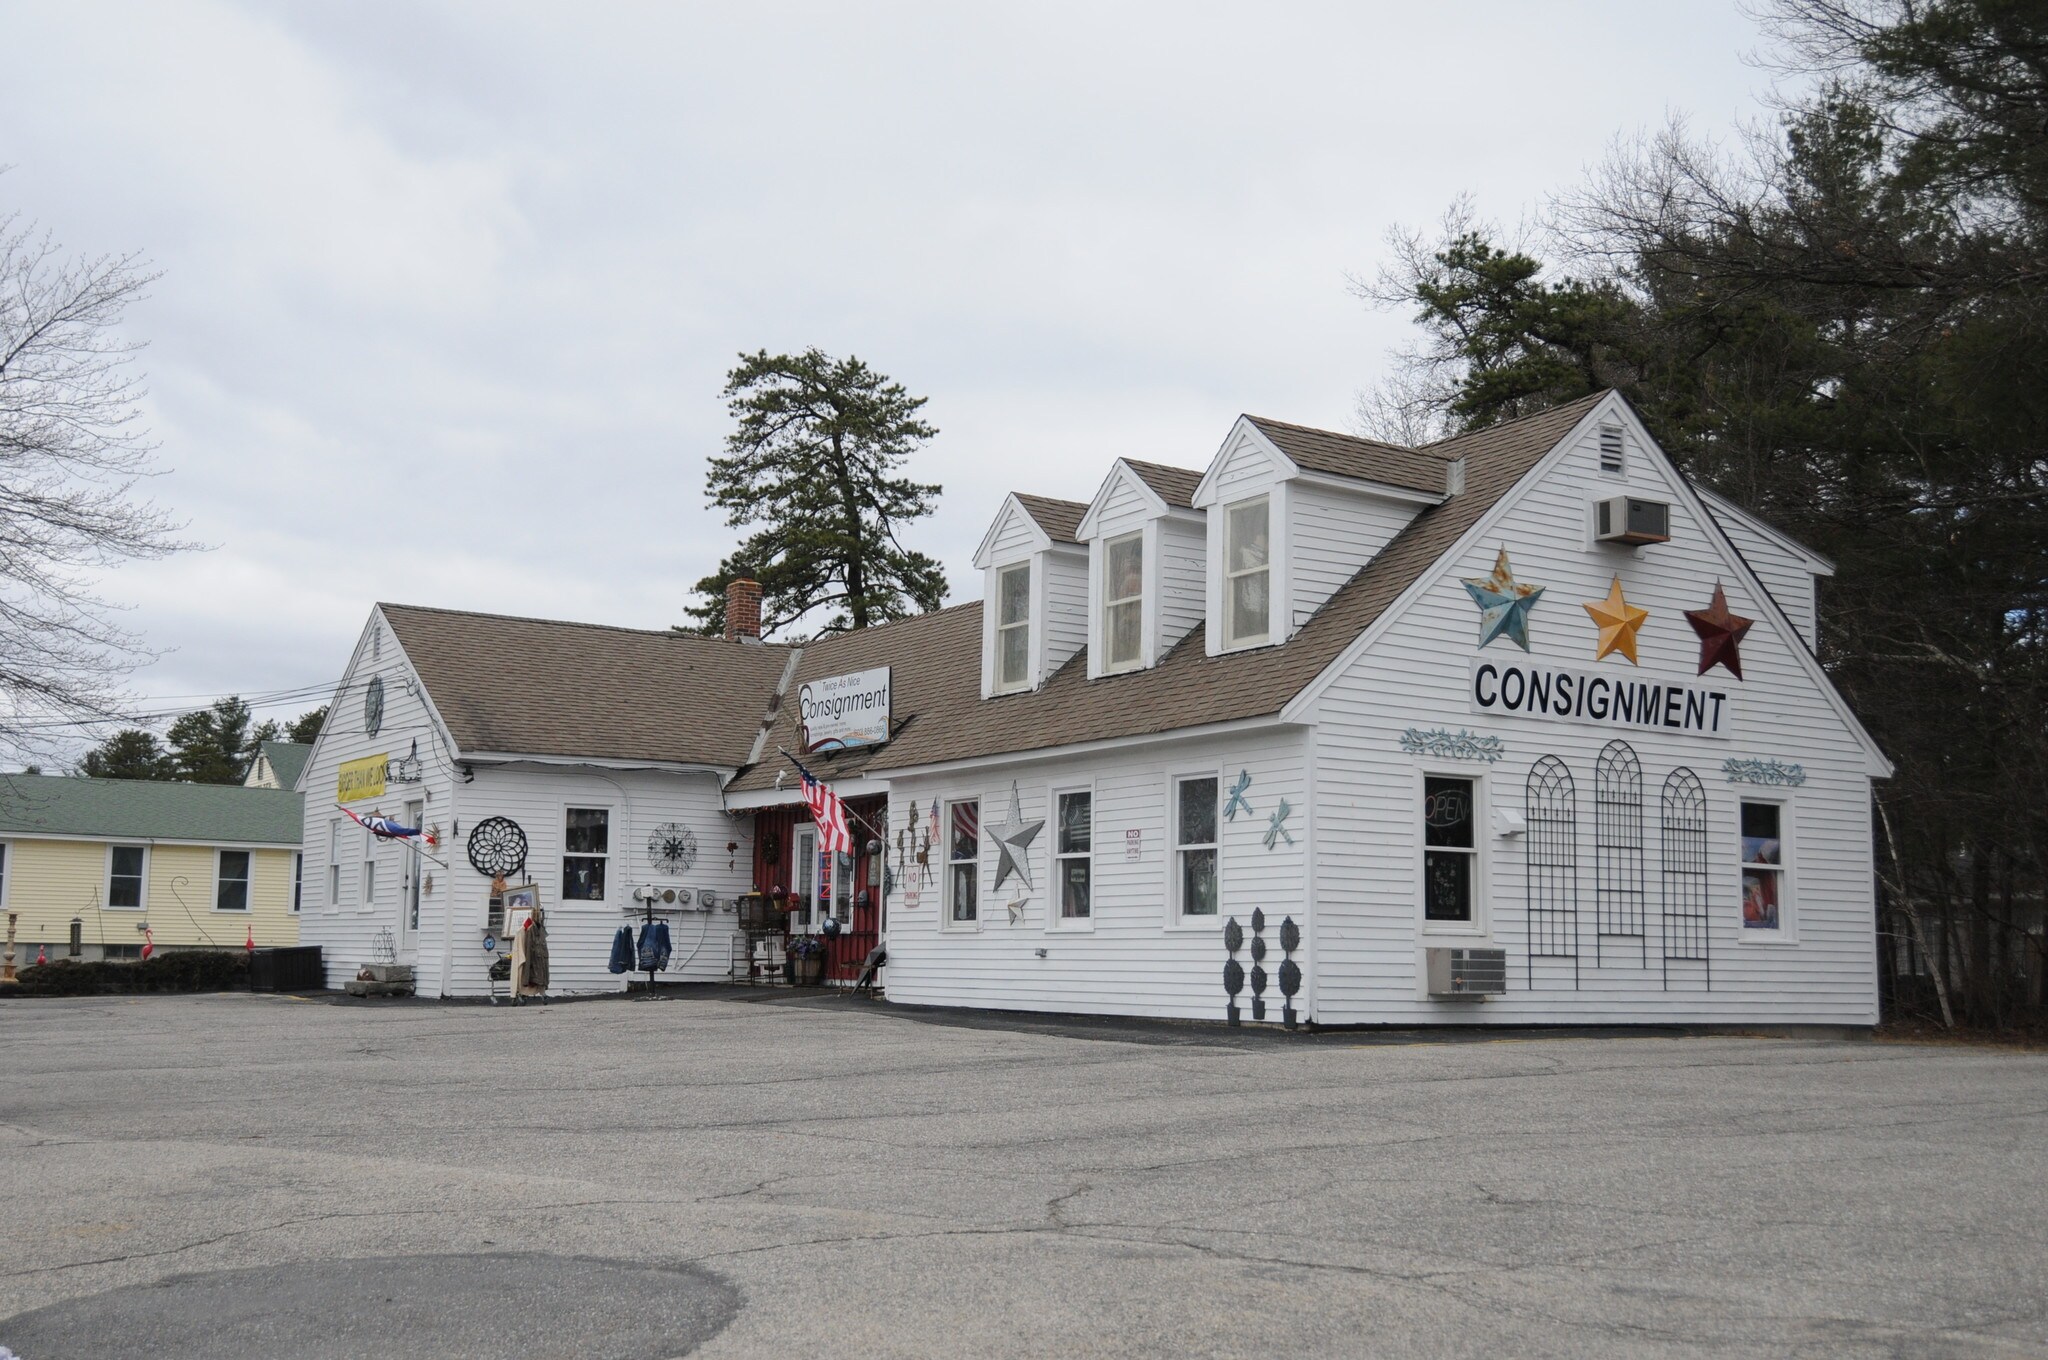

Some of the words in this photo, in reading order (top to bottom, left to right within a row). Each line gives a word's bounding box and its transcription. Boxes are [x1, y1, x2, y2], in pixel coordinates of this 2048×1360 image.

[823, 681, 837, 691] Twice
[838, 679, 846, 688] As
[847, 677, 860, 687] Nice
[801, 685, 886, 720] Consignment
[1475, 664, 1726, 731] CONSIGNMENT
[1425, 795, 1467, 821] OPEN
[1127, 830, 1139, 838] NO
[908, 872, 917, 883] NO
